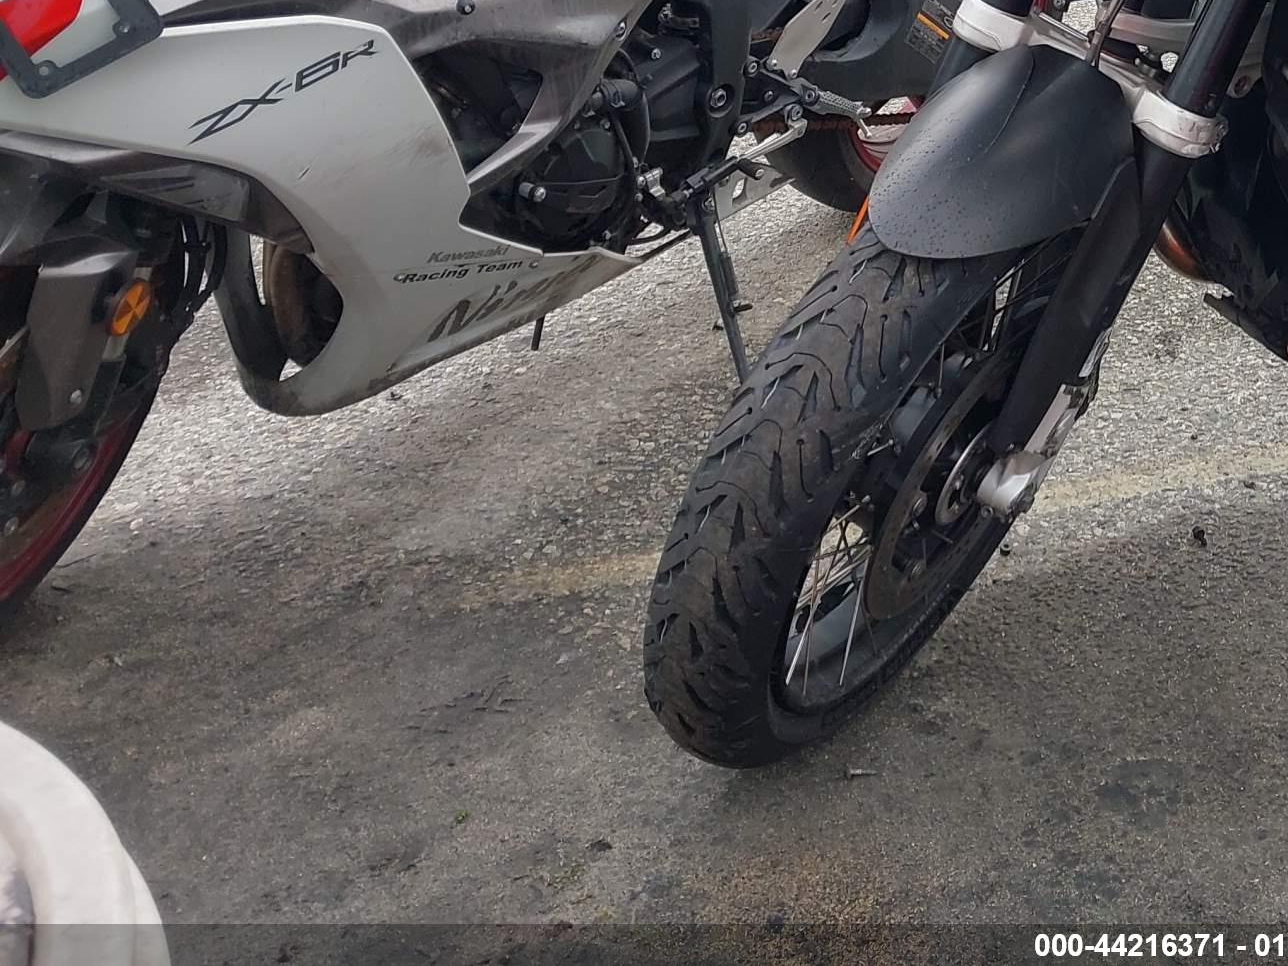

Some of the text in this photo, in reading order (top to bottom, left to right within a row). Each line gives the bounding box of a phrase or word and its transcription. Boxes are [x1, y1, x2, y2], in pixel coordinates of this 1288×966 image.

[186, 39, 380, 147] ZX-6R
[427, 244, 510, 265] Kawasaki
[402, 260, 524, 284] Racing Team
